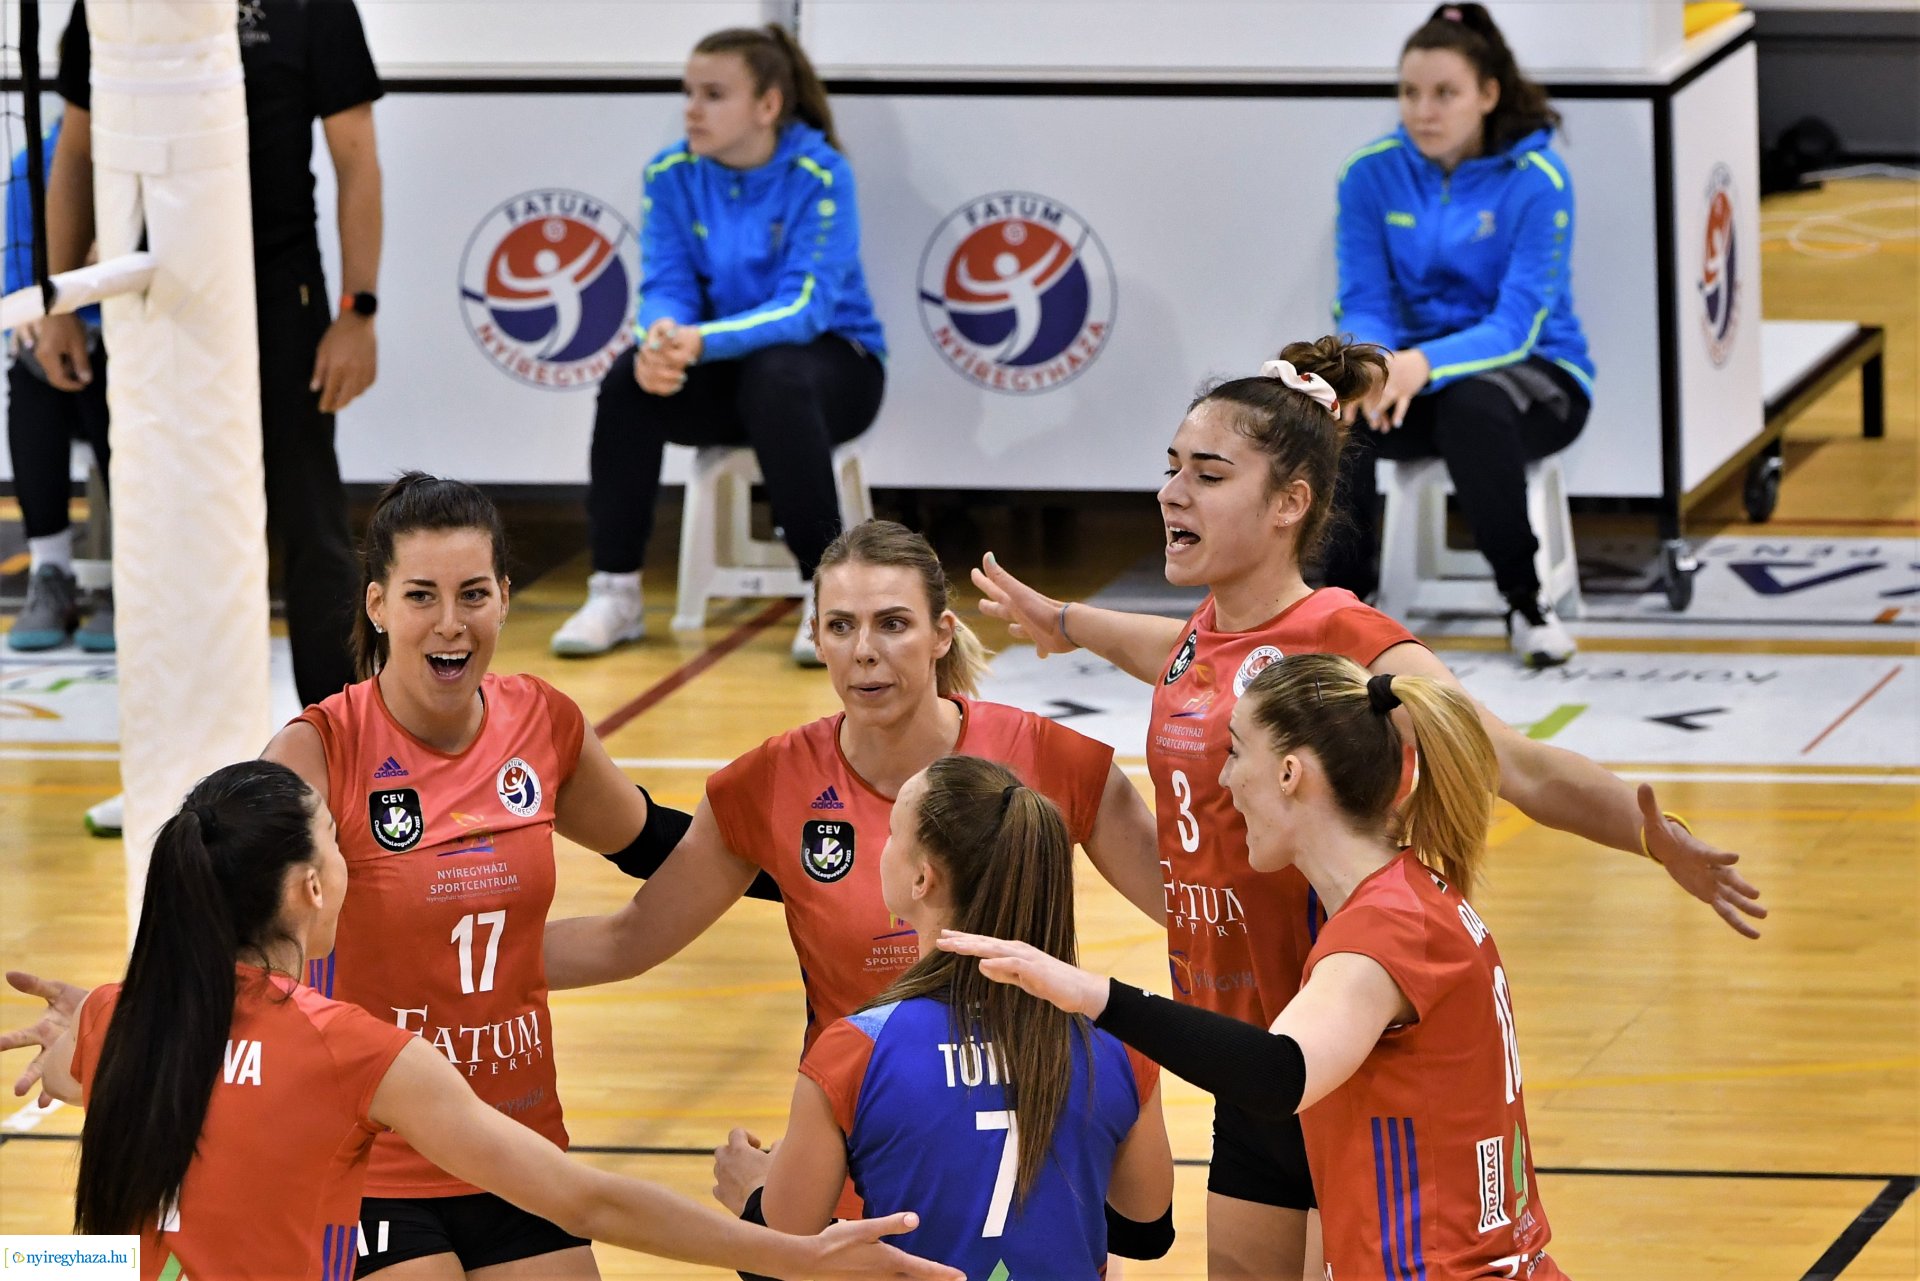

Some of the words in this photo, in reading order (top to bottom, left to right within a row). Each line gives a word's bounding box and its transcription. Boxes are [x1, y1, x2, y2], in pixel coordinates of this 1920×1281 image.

[504, 193, 602, 225] FATUM
[966, 195, 1064, 225] FATUM
[1155, 735, 1206, 752] SPORTCENTRUM
[373, 768, 409, 779] adidas
[504, 760, 523, 771] FATUM
[381, 793, 405, 805] CEV
[811, 799, 844, 810] adidas
[1171, 769, 1200, 853] 3
[817, 824, 841, 835] CEV
[437, 862, 508, 880] NYÍREGYHÁZI
[430, 875, 518, 895] SPORTCENTRUM
[450, 909, 507, 995] 17
[872, 945, 919, 955] NYÍREG
[937, 1035, 1011, 1088] TÓT
[975, 1109, 1020, 1238] 7
[1486, 1142, 1498, 1226] STRABAG
